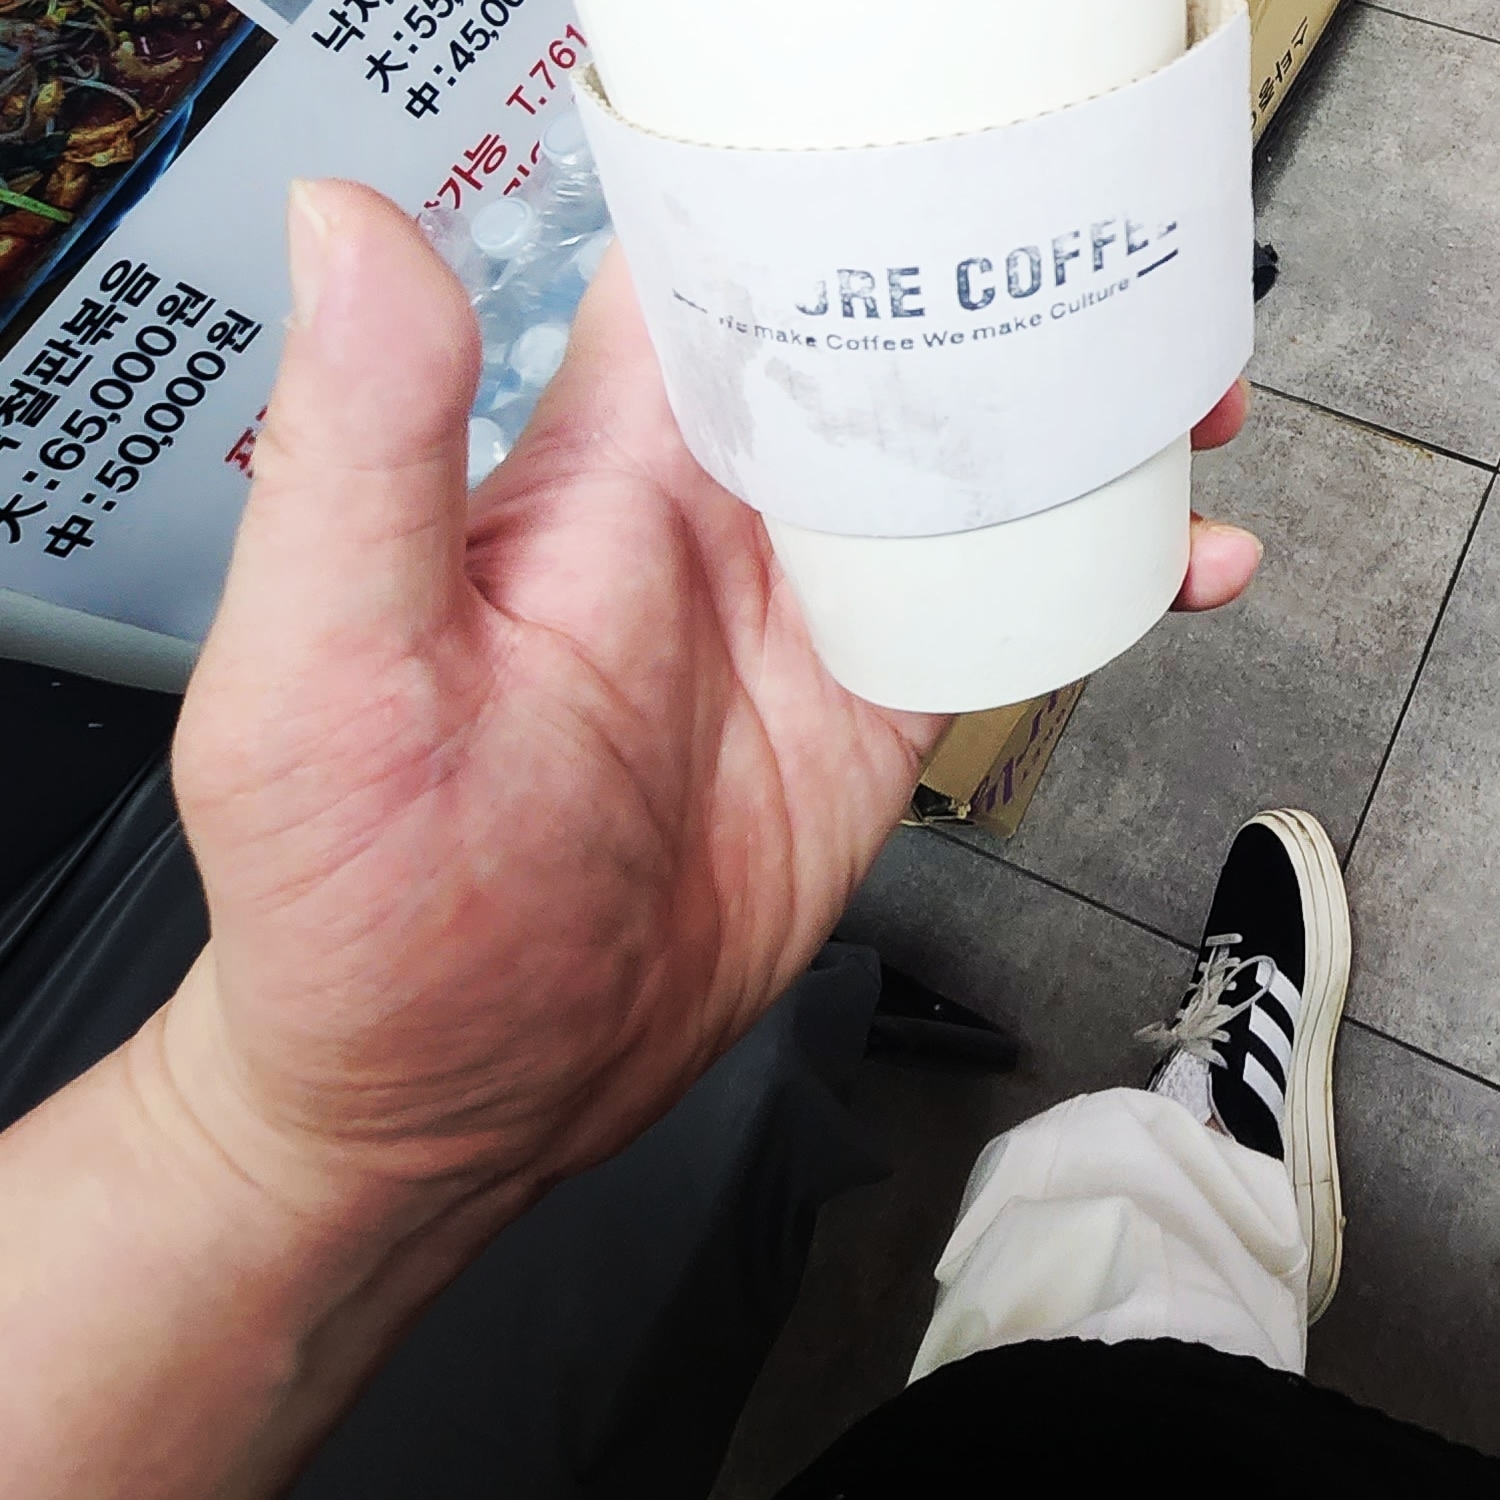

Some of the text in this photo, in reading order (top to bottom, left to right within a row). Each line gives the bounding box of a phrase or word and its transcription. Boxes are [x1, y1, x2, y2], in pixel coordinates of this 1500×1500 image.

[423, 132, 508, 210] 가능
[956, 212, 1178, 311] COFFE
[0, 259, 161, 451] 철판볶음
[753, 324, 817, 348] make
[826, 333, 915, 351] Coffee
[922, 329, 964, 348] We
[972, 313, 1042, 341] make
[1049, 278, 1130, 320] Culture
